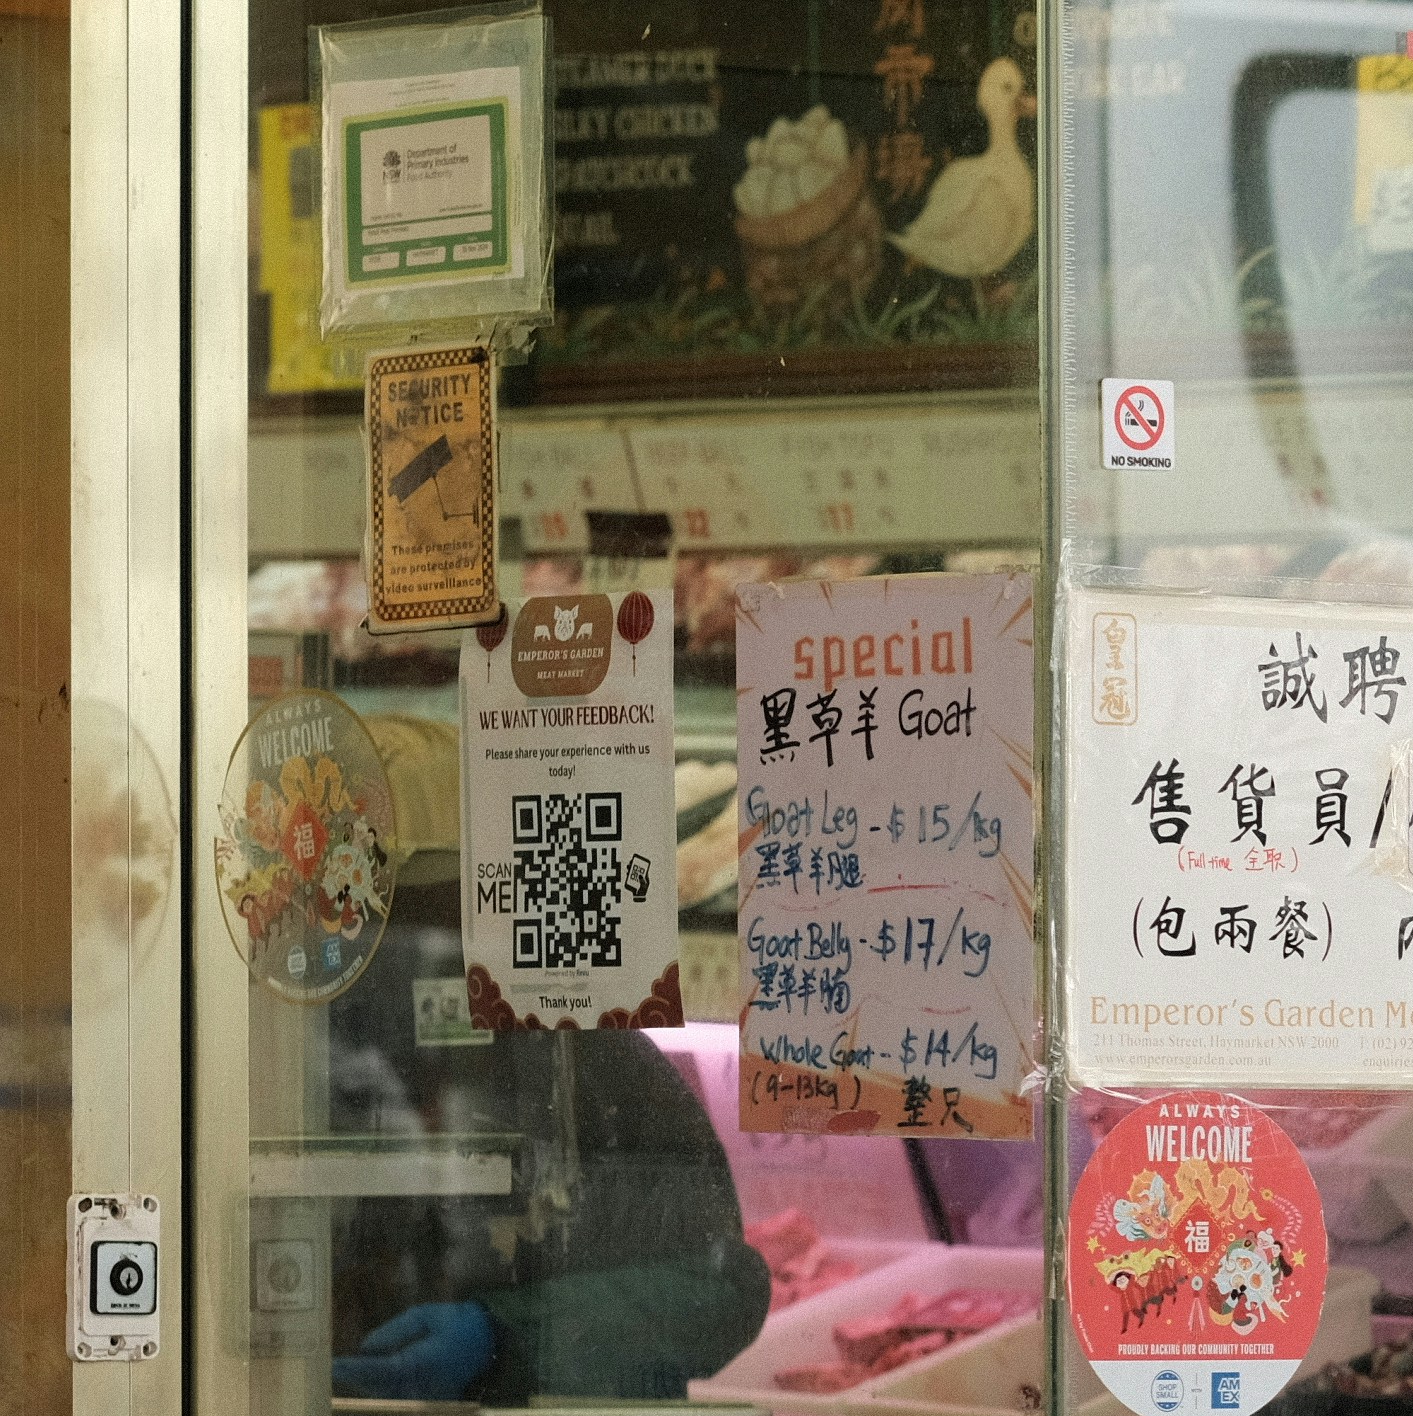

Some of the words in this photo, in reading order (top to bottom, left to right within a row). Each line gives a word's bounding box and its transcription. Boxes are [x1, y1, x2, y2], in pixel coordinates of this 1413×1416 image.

[388, 373, 471, 402] SECURITY
[397, 402, 464, 428] NOTICE
[1111, 455, 1126, 468] NO
[1128, 456, 1172, 469] SMOKING
[392, 544, 424, 556] These
[425, 539, 474, 554] premises
[390, 565, 407, 575] are
[410, 559, 460, 575] protected
[385, 582, 415, 596] video
[416, 577, 483, 593] surveillance
[517, 649, 568, 662] EMPEROR'S
[569, 646, 605, 661] GARDEN
[794, 617, 973, 692] special
[558, 669, 585, 679] MARKET
[1258, 631, 1408, 725] 誠聘
[266, 699, 323, 725] ALWAYS
[479, 710, 499, 731] WE
[501, 708, 539, 730] WANT
[541, 706, 575, 728] YOUR
[576, 704, 656, 726] FEEDBACK!
[898, 687, 977, 740] Goat
[257, 717, 334, 769] WELCOME
[485, 748, 513, 760] Please
[514, 747, 538, 760] share
[539, 748, 560, 762] your
[561, 744, 612, 761] experience
[614, 743, 636, 755] with
[638, 744, 651, 755] us
[549, 765, 576, 780] today!
[748, 786, 814, 838] Goat
[821, 790, 859, 850] Leg
[477, 862, 512, 879] SCAN
[477, 881, 512, 914] ME
[1133, 896, 1333, 962] (包兩餐)
[747, 916, 803, 966] Goat
[803, 920, 852, 972] Belly
[539, 996, 568, 1009] Thank
[569, 995, 593, 1011] you!
[1090, 996, 1255, 1032] Emperor's
[1264, 1000, 1374, 1029] Garden
[760, 1033, 828, 1070] Whole
[1119, 1034, 1163, 1047] Thomas
[1210, 1035, 1274, 1051] Haymarket
[1277, 1036, 1306, 1048] NSW
[1311, 1036, 1340, 1048] 2000
[1372, 1037, 1396, 1050] (02)
[1095, 1055, 1272, 1068] www.emperorsgarden.com.au
[1159, 1103, 1241, 1119] ALWAYS
[1145, 1125, 1254, 1164] WELCOME
[1185, 1219, 1211, 1253] 福
[1118, 1343, 1149, 1355] PROUDLY
[1150, 1343, 1181, 1355] BACKING
[1182, 1343, 1197, 1355] OUR
[1198, 1343, 1239, 1355] COMMUNITY
[1240, 1343, 1275, 1355] TOGETHER
[1156, 1390, 1179, 1400] SMALL
[1157, 1384, 1178, 1392] SHOP
